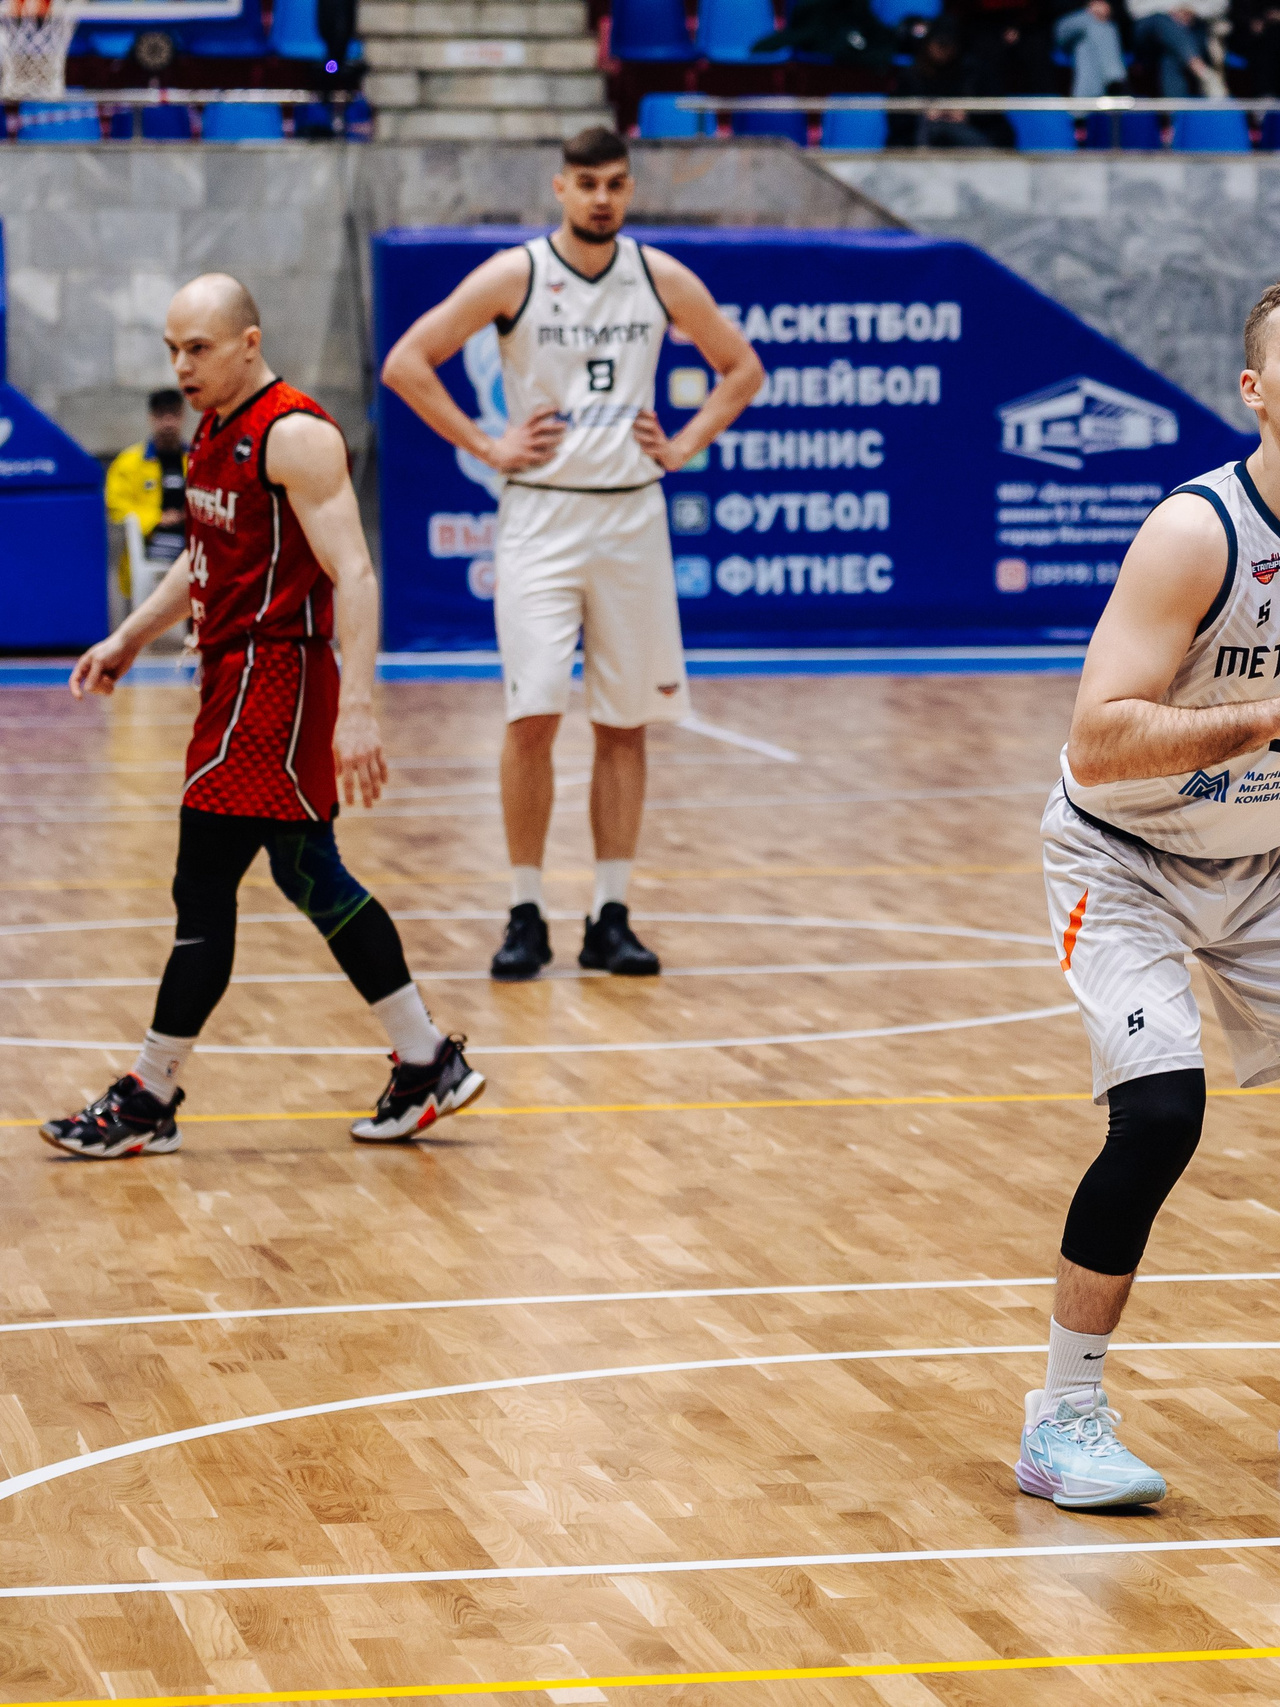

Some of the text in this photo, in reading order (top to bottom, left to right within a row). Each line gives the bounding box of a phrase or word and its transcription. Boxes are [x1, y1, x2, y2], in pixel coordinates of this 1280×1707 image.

[587, 360, 614, 391] 8
[750, 359, 942, 407] ЛЕЙБОЛ
[715, 428, 885, 470] ТЕННИС
[715, 491, 890, 533] ФУТБОЛ
[715, 553, 895, 596] ФИТНЕС
